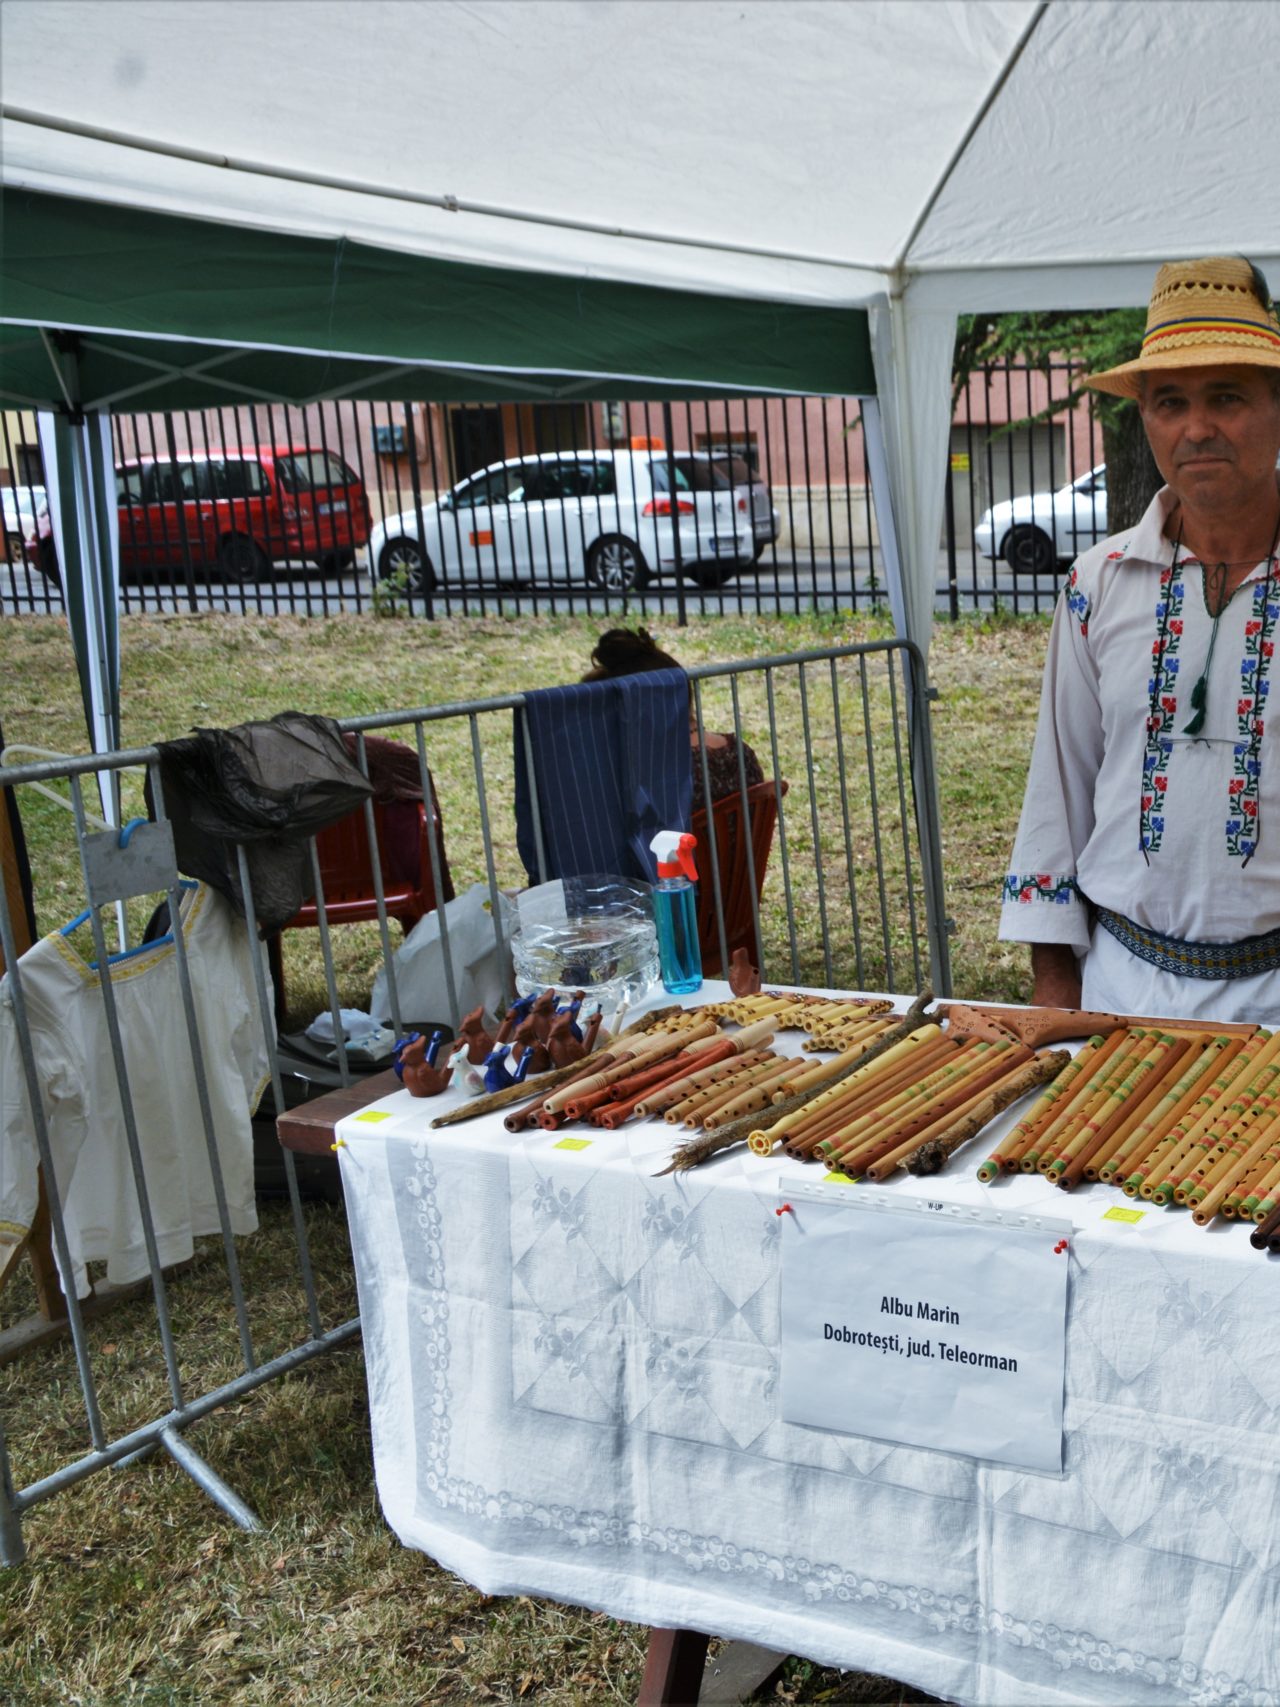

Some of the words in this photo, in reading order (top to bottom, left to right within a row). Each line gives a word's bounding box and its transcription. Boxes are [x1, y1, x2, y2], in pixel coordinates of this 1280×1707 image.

[880, 1296, 913, 1318] Albu
[916, 1301, 960, 1326] Marin
[823, 1323, 904, 1355] Dobrotești,
[906, 1336, 935, 1358] jud.
[938, 1342, 1018, 1373] Teleorman
